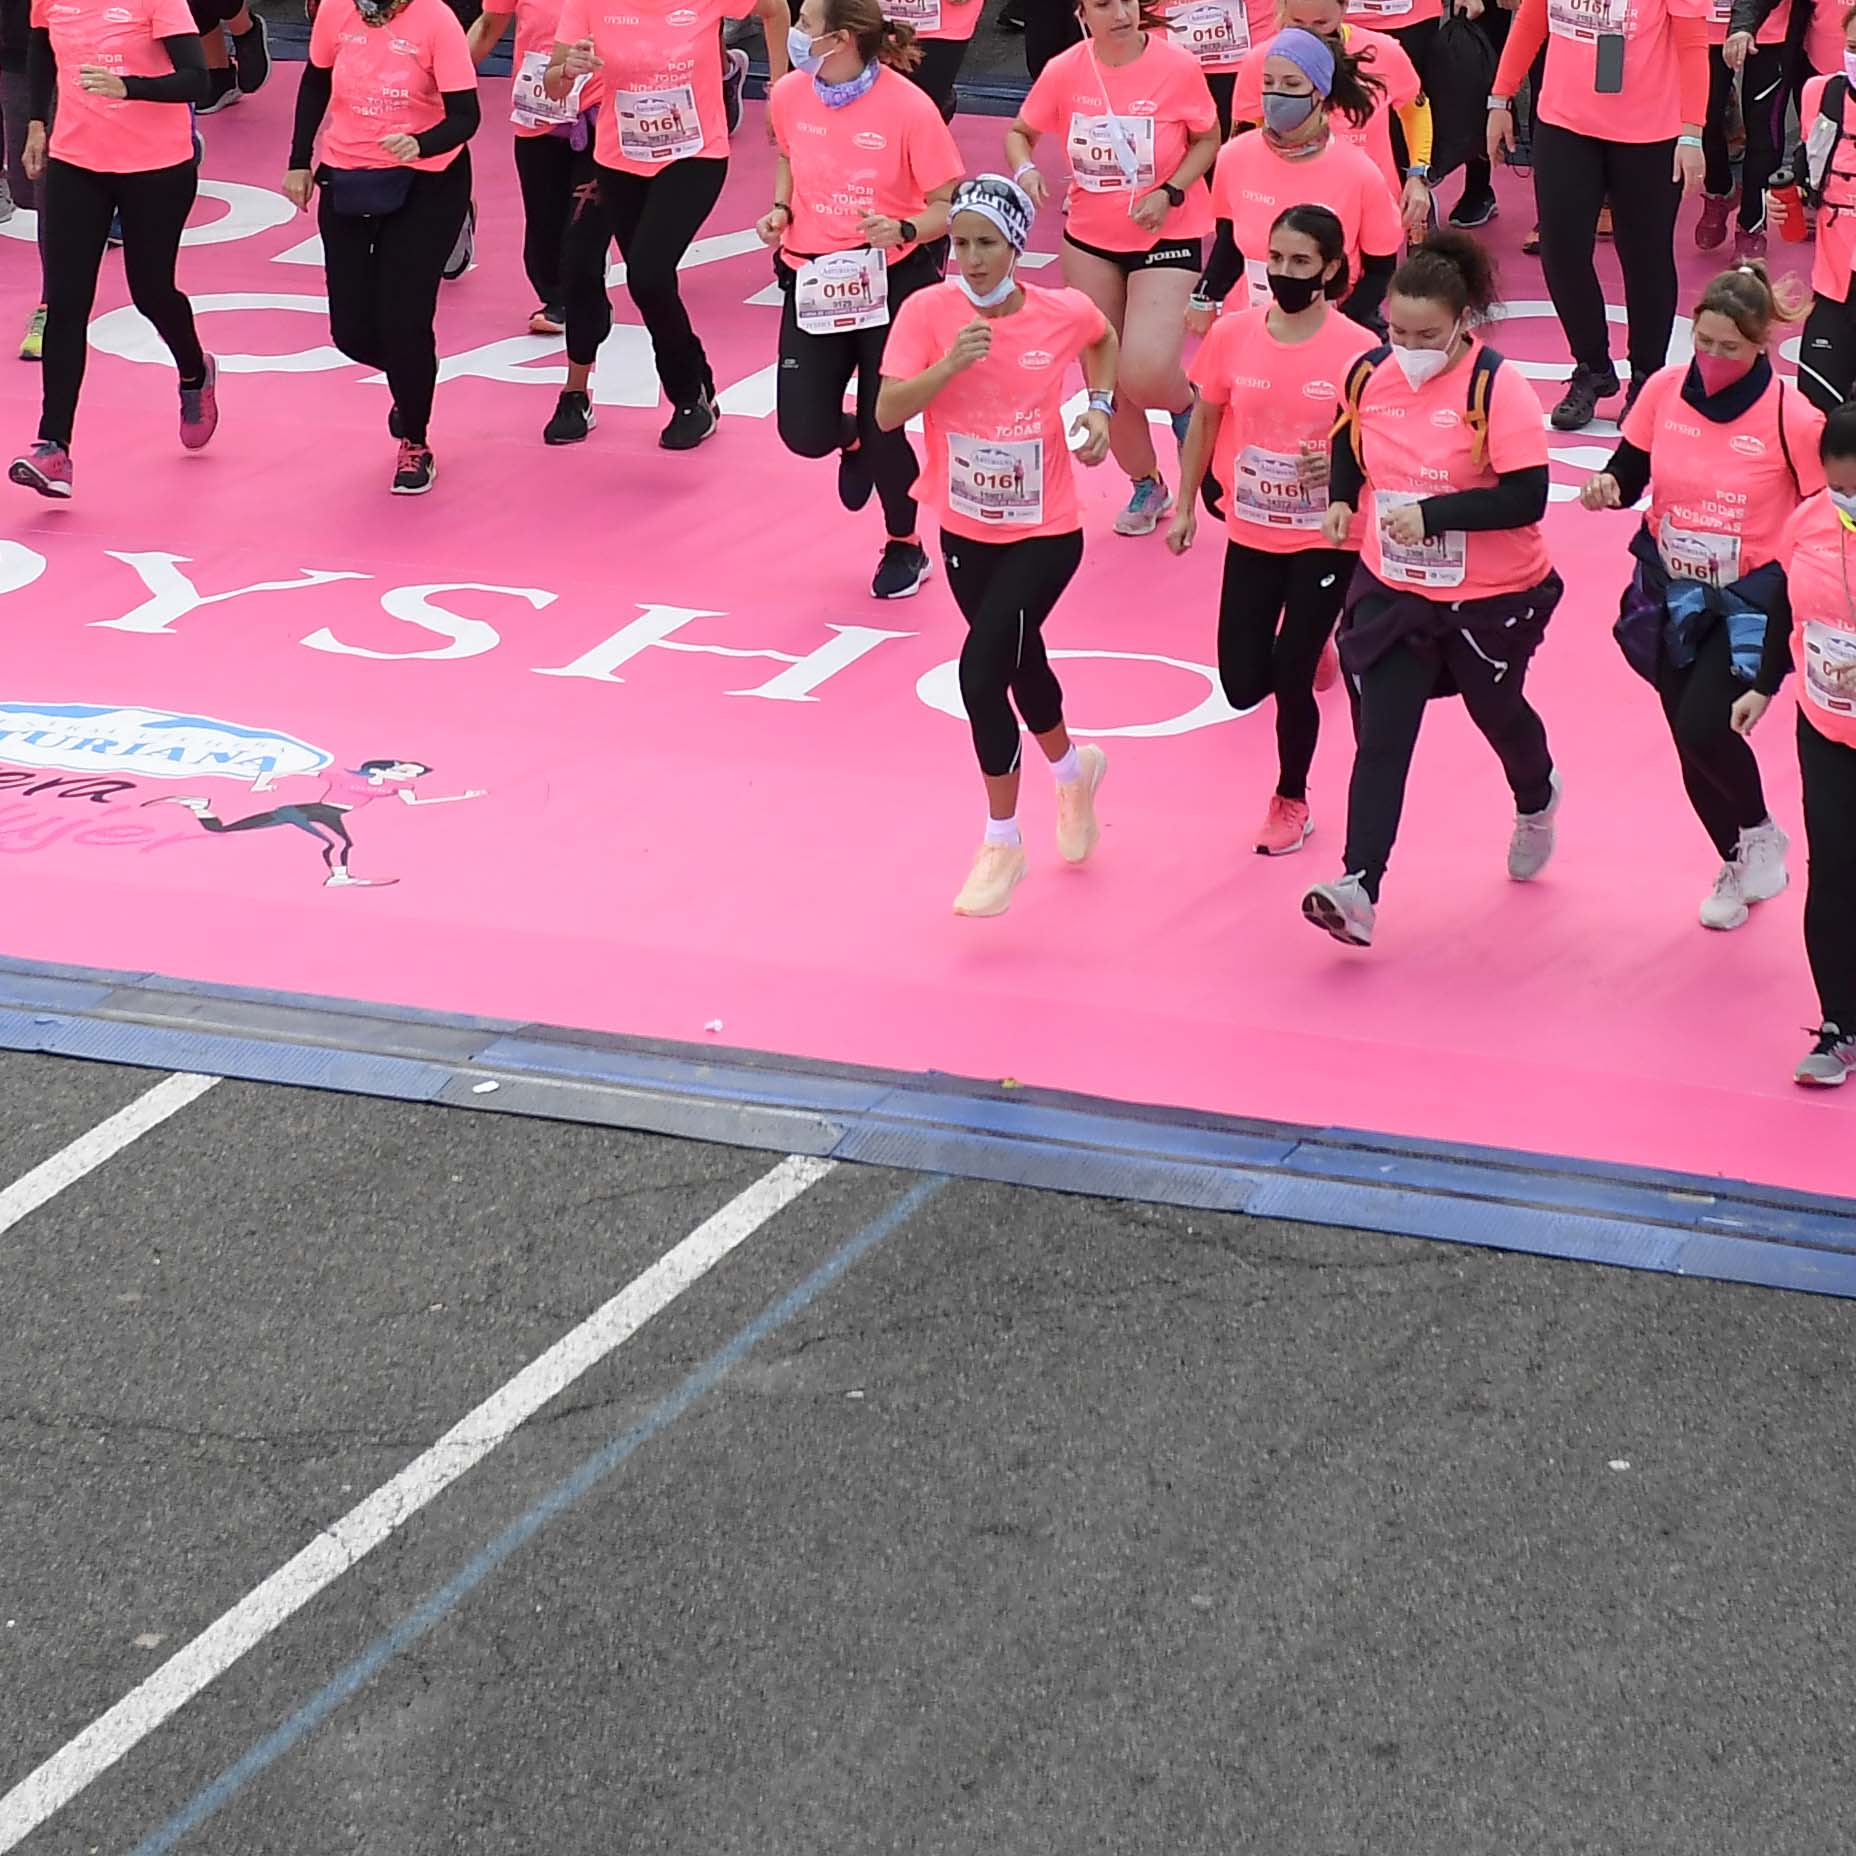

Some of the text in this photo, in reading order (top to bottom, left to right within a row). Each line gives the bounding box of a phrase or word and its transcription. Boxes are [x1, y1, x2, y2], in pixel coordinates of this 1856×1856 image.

[1193, 26, 1225, 41] 016
[96, 53, 123, 64] POR
[383, 87, 409, 98] POR
[640, 118, 672, 132] 016
[1089, 145, 1113, 162] 01
[824, 282, 860, 297] 016
[995, 422, 1042, 438] TODAS
[974, 472, 1012, 488] 016
[1419, 467, 1449, 481] POR
[1261, 481, 1298, 497] 016
[1670, 558, 1709, 576] 016
